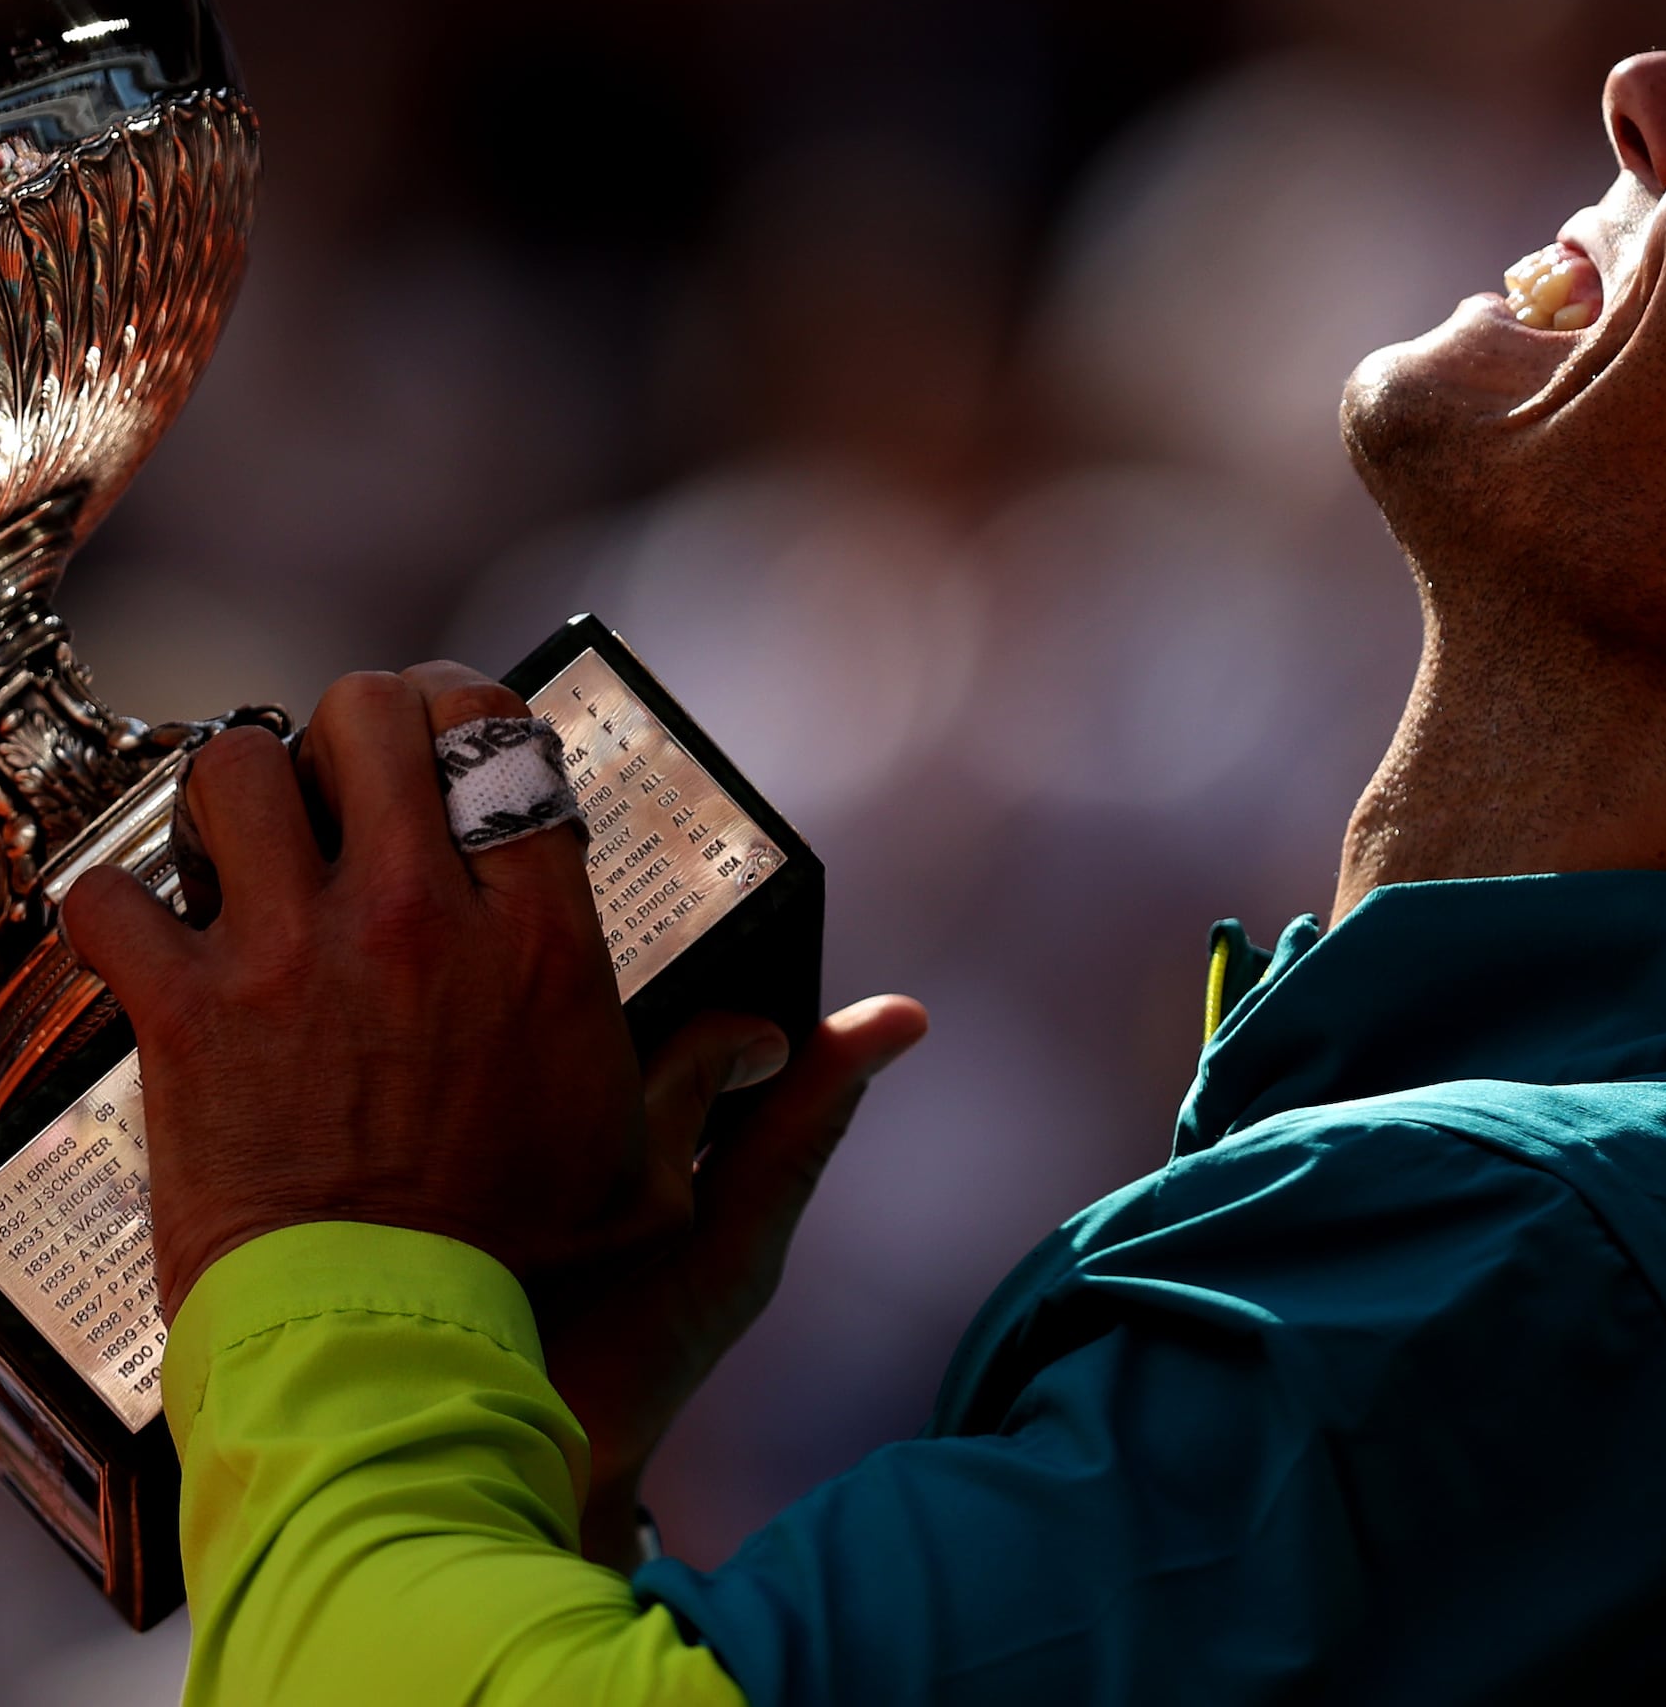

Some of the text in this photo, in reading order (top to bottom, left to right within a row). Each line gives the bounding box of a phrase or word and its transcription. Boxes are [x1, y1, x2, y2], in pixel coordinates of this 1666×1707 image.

[572, 686, 582, 700] F
[587, 703, 597, 718] F
[603, 720, 614, 734] F
[619, 737, 630, 751] F
[618, 754, 647, 783] AUST
[594, 799, 632, 835] CRAMM
[641, 773, 664, 794] ALL
[658, 790, 679, 808] GB
[606, 866, 627, 885] VON
[625, 832, 663, 868] CRAMM
[672, 807, 695, 828] ALL
[609, 824, 710, 913] H.HENKEL ALL
[717, 856, 742, 878] USA
[624, 875, 683, 930] D.BUDGE
[702, 839, 727, 861] USA
[14, 1137, 77, 1194] H.BRIGGS
[95, 1102, 115, 1122] GB
[33, 1137, 113, 1211] J.SCHOPFER
[119, 1118, 128, 1132] F
[8, 1226, 44, 1261] 1893
[134, 1135, 143, 1149] F
[24, 1170, 142, 1278] 1894 A.VACHEROT
[40, 1261, 75, 1294] 1895
[55, 1278, 91, 1311] 1896
[70, 1293, 103, 1327] 1897
[86, 1312, 121, 1344] 1898
[102, 1328, 138, 1361] 1899
[118, 1345, 153, 1378] 1900
[134, 1366, 162, 1394] 190
